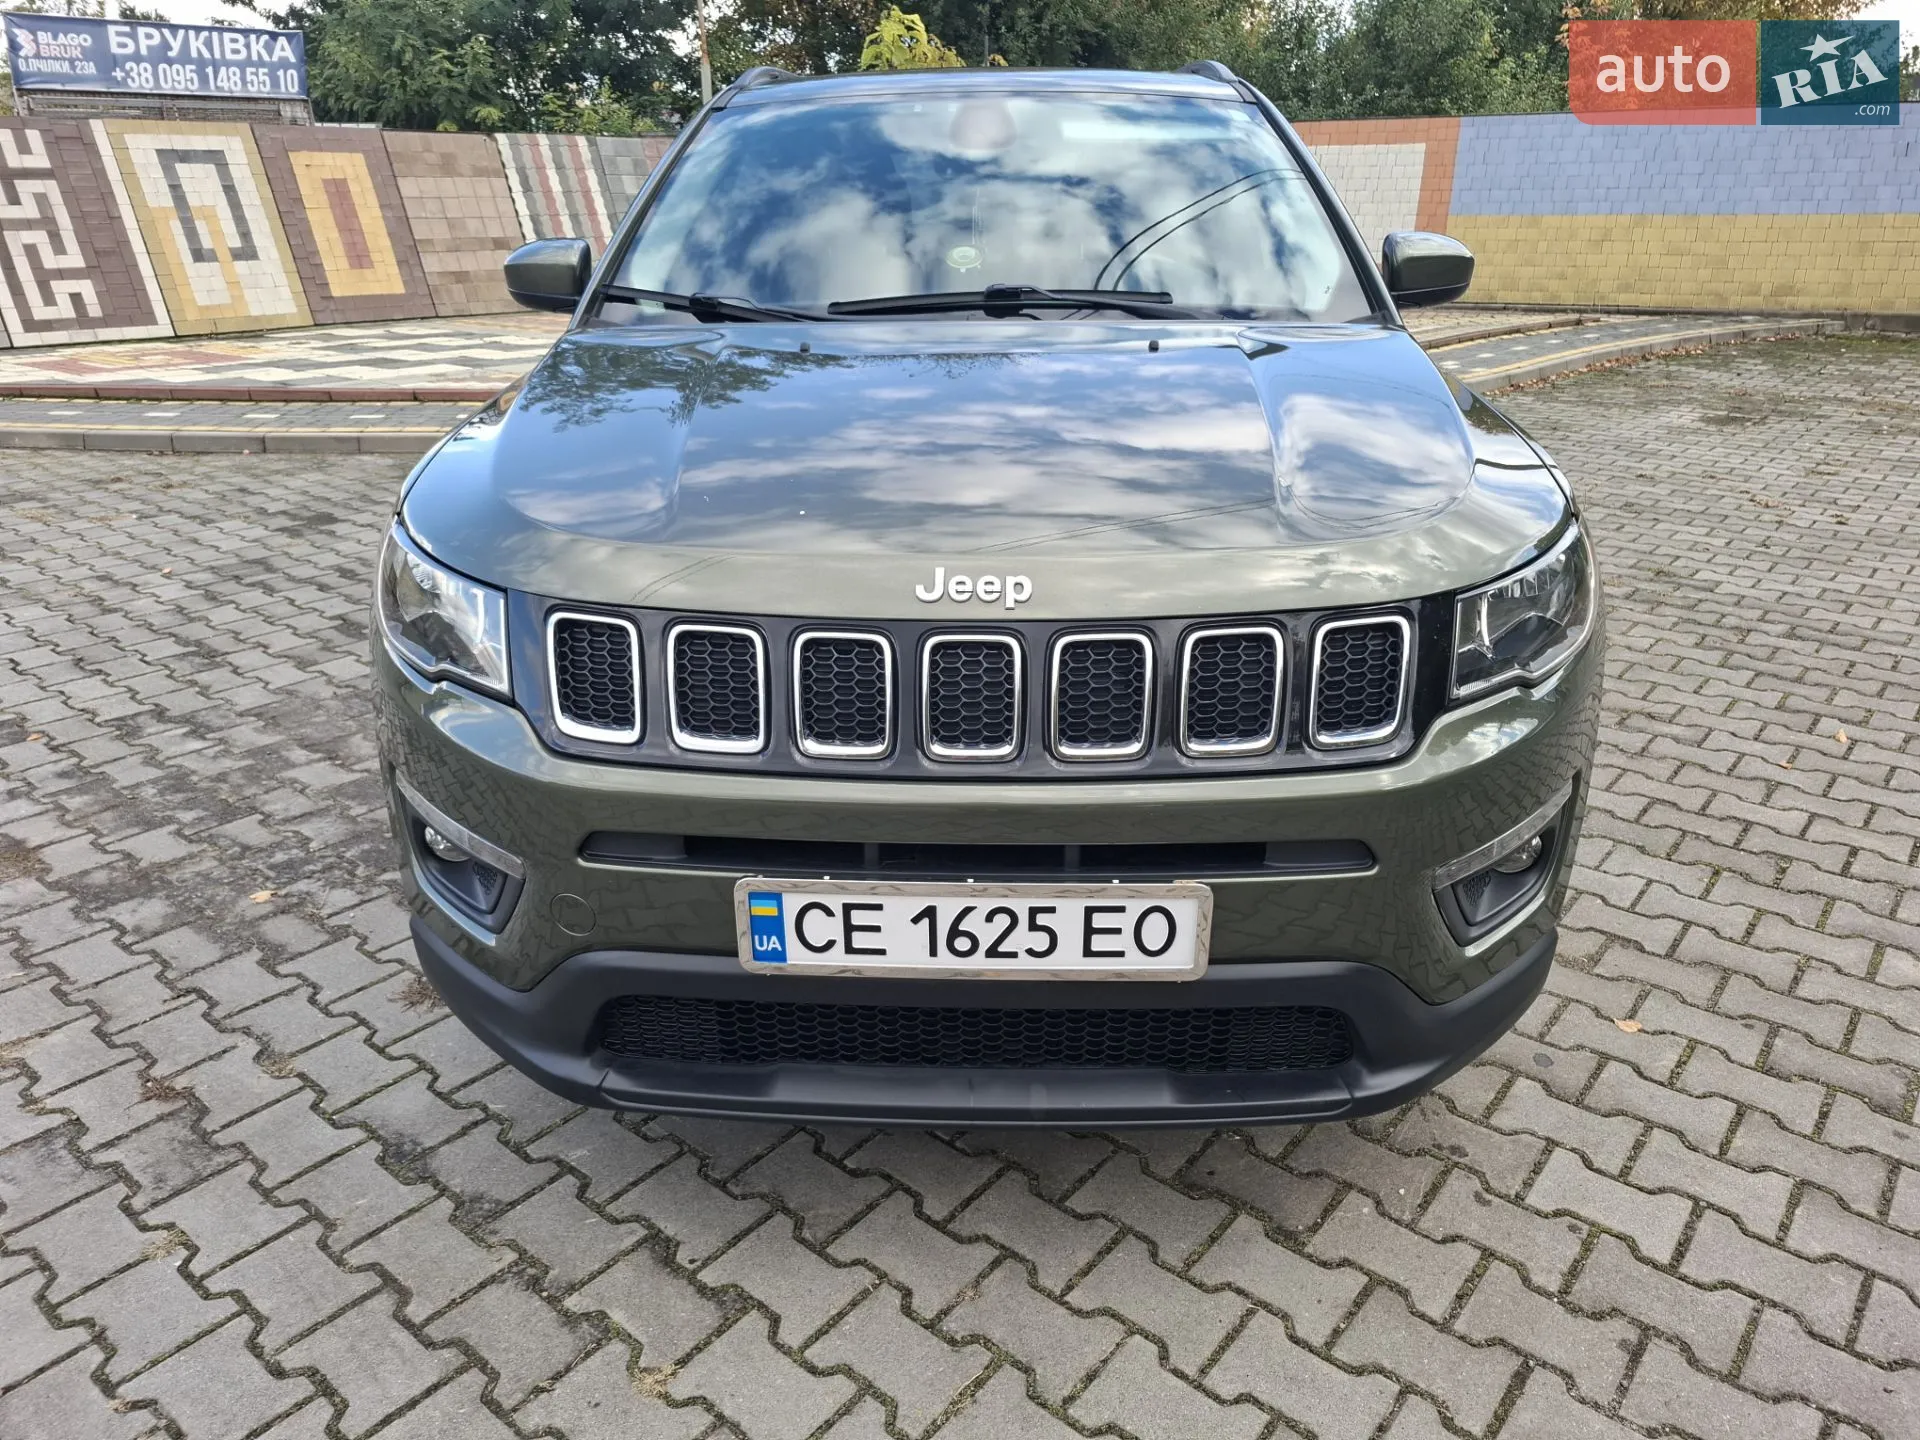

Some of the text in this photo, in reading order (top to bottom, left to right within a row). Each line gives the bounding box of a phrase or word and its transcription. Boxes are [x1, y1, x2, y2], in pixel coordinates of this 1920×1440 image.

[37, 31, 92, 47] BLAGO
[39, 45, 82, 58] BRUK
[107, 24, 296, 63] БРУКІВКА
[111, 61, 299, 93] +38 095 148 55 10
[915, 566, 1033, 610] Jeep
[755, 935, 783, 952] UA
[794, 901, 1177, 958] CE 1625 EO
